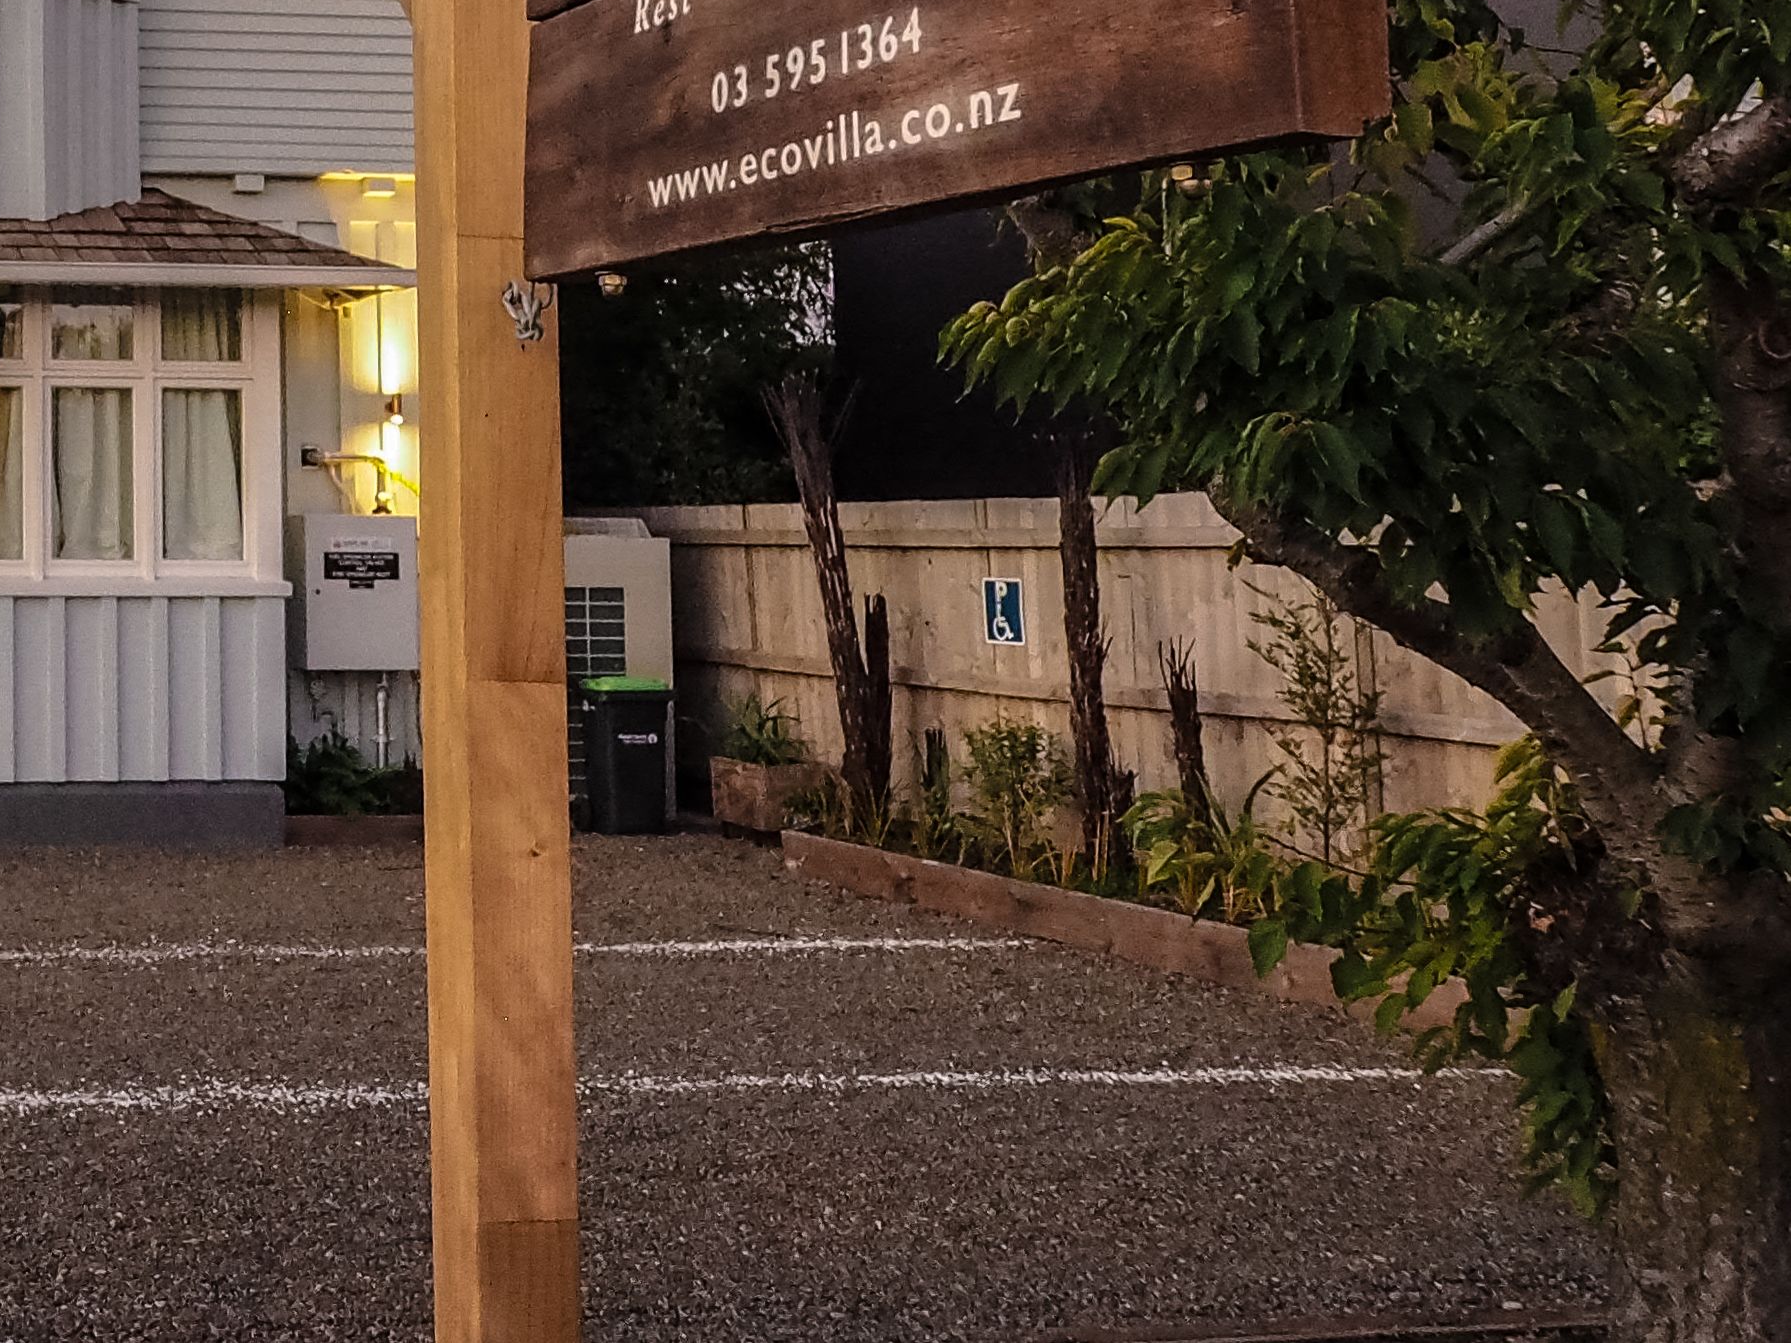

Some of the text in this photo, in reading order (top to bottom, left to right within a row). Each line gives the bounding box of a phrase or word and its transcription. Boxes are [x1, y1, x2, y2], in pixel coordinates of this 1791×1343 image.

[711, 6, 924, 113] 03 595 1364
[647, 82, 1022, 208] www.ecovilla.co.nz
